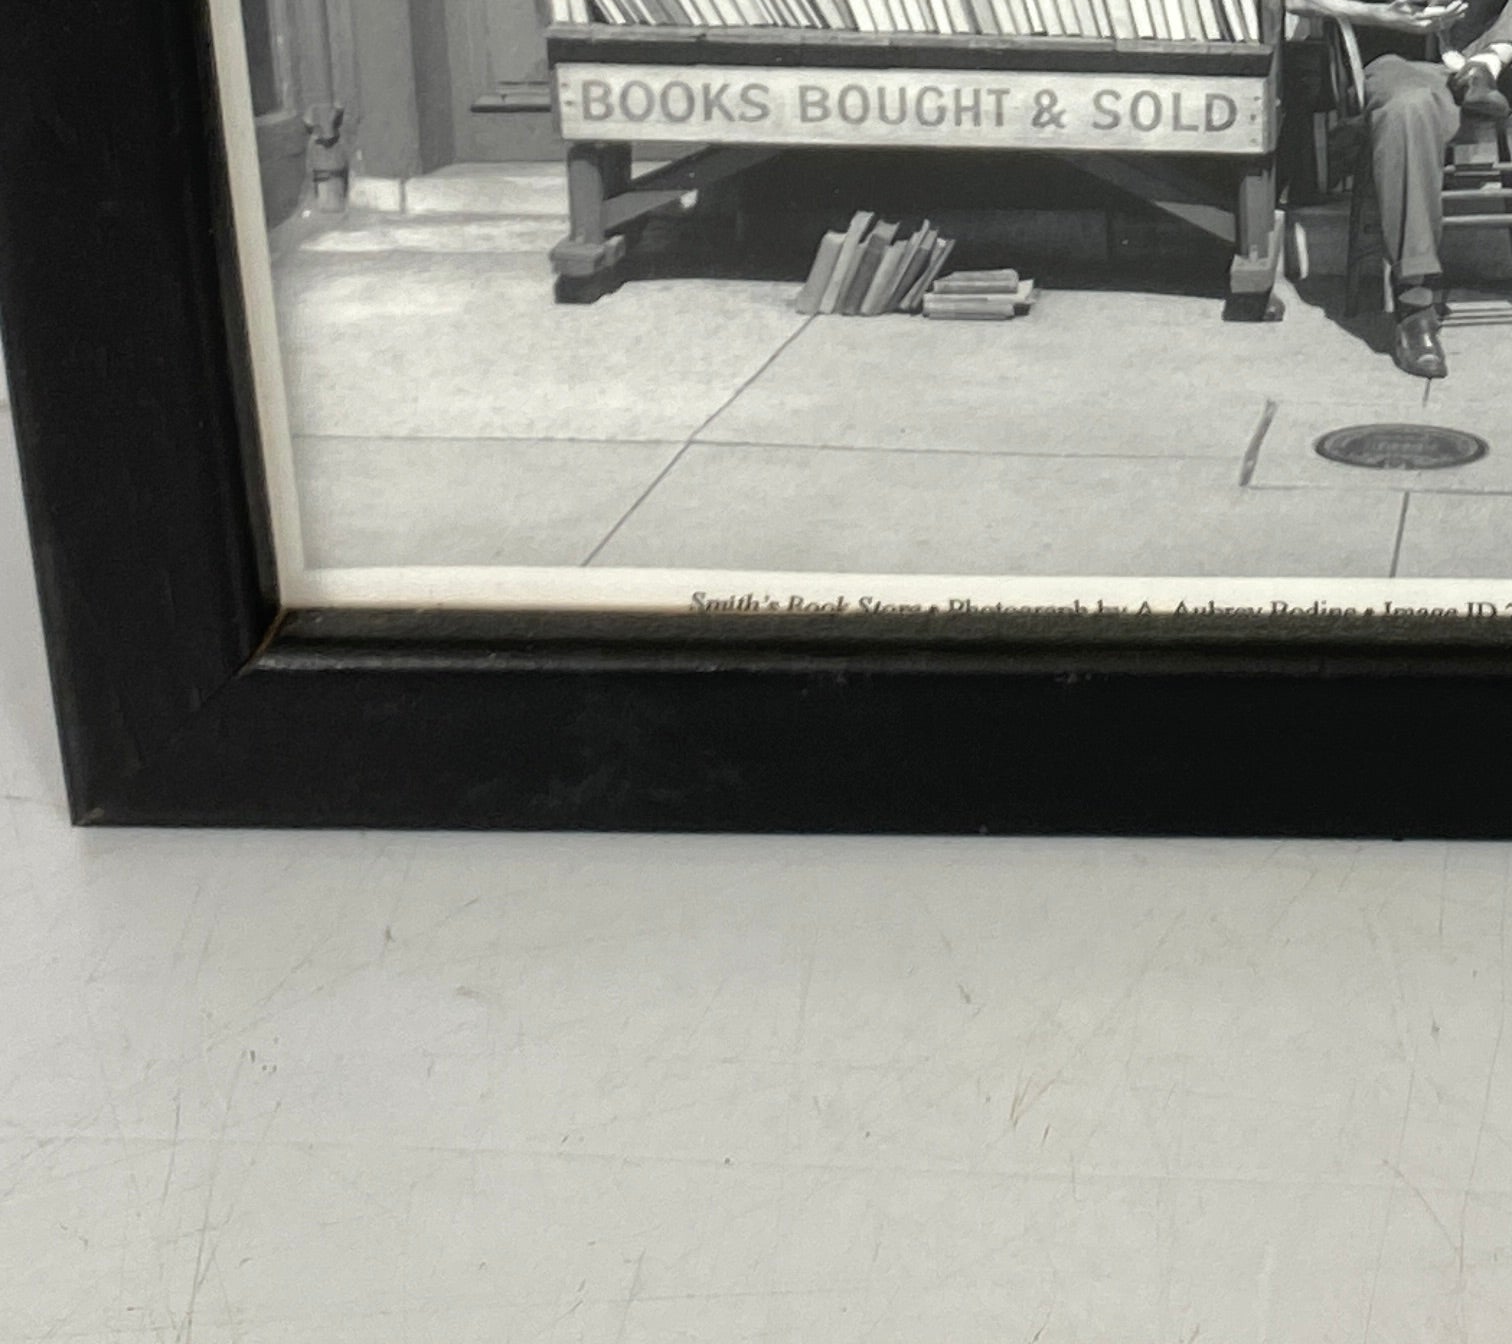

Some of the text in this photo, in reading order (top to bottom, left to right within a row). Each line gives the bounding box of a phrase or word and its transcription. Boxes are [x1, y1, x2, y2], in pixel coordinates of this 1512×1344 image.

[580, 78, 1238, 133] BOOKS BOUGHT & SOLD
